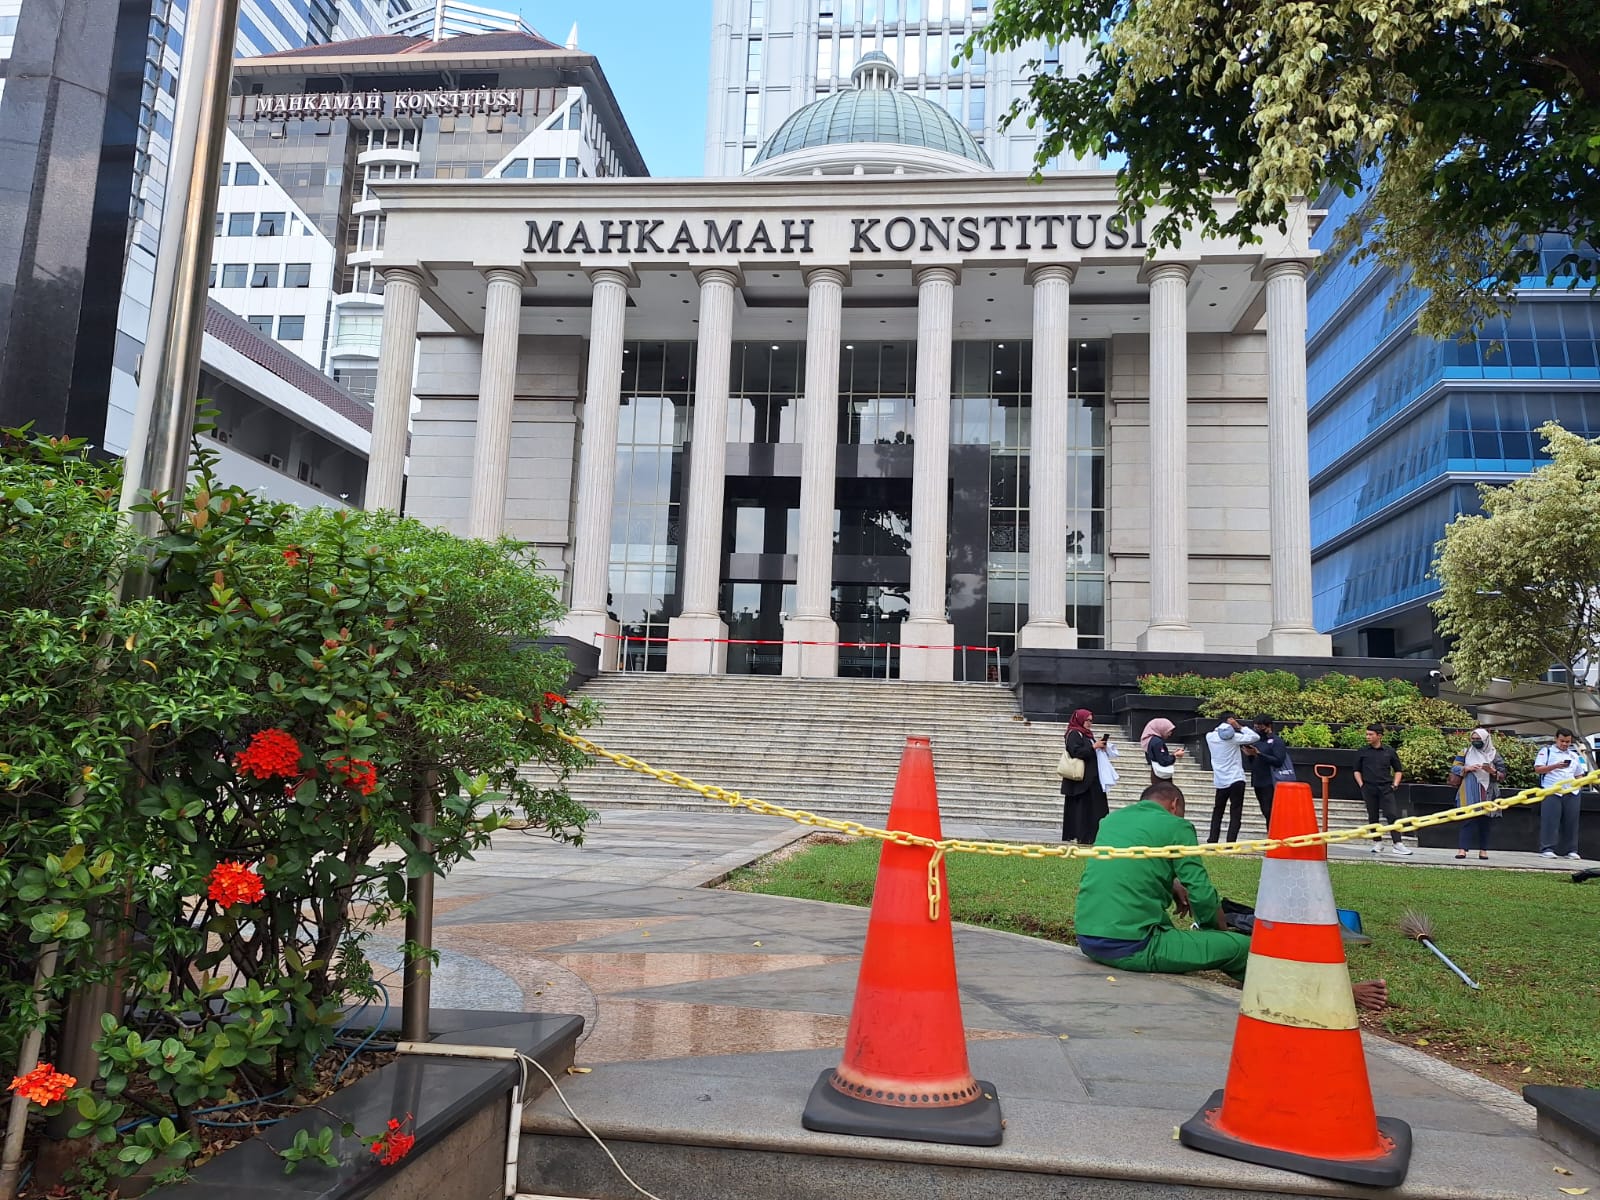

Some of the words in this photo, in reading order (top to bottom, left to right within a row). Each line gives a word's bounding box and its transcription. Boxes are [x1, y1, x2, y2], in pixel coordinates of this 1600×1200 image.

[255, 94, 381, 112] MAHKAMAH
[394, 91, 517, 109] KONSTITUSI
[523, 219, 814, 253] MAHKAMAH
[850, 214, 1147, 252] KONSTITUSI
